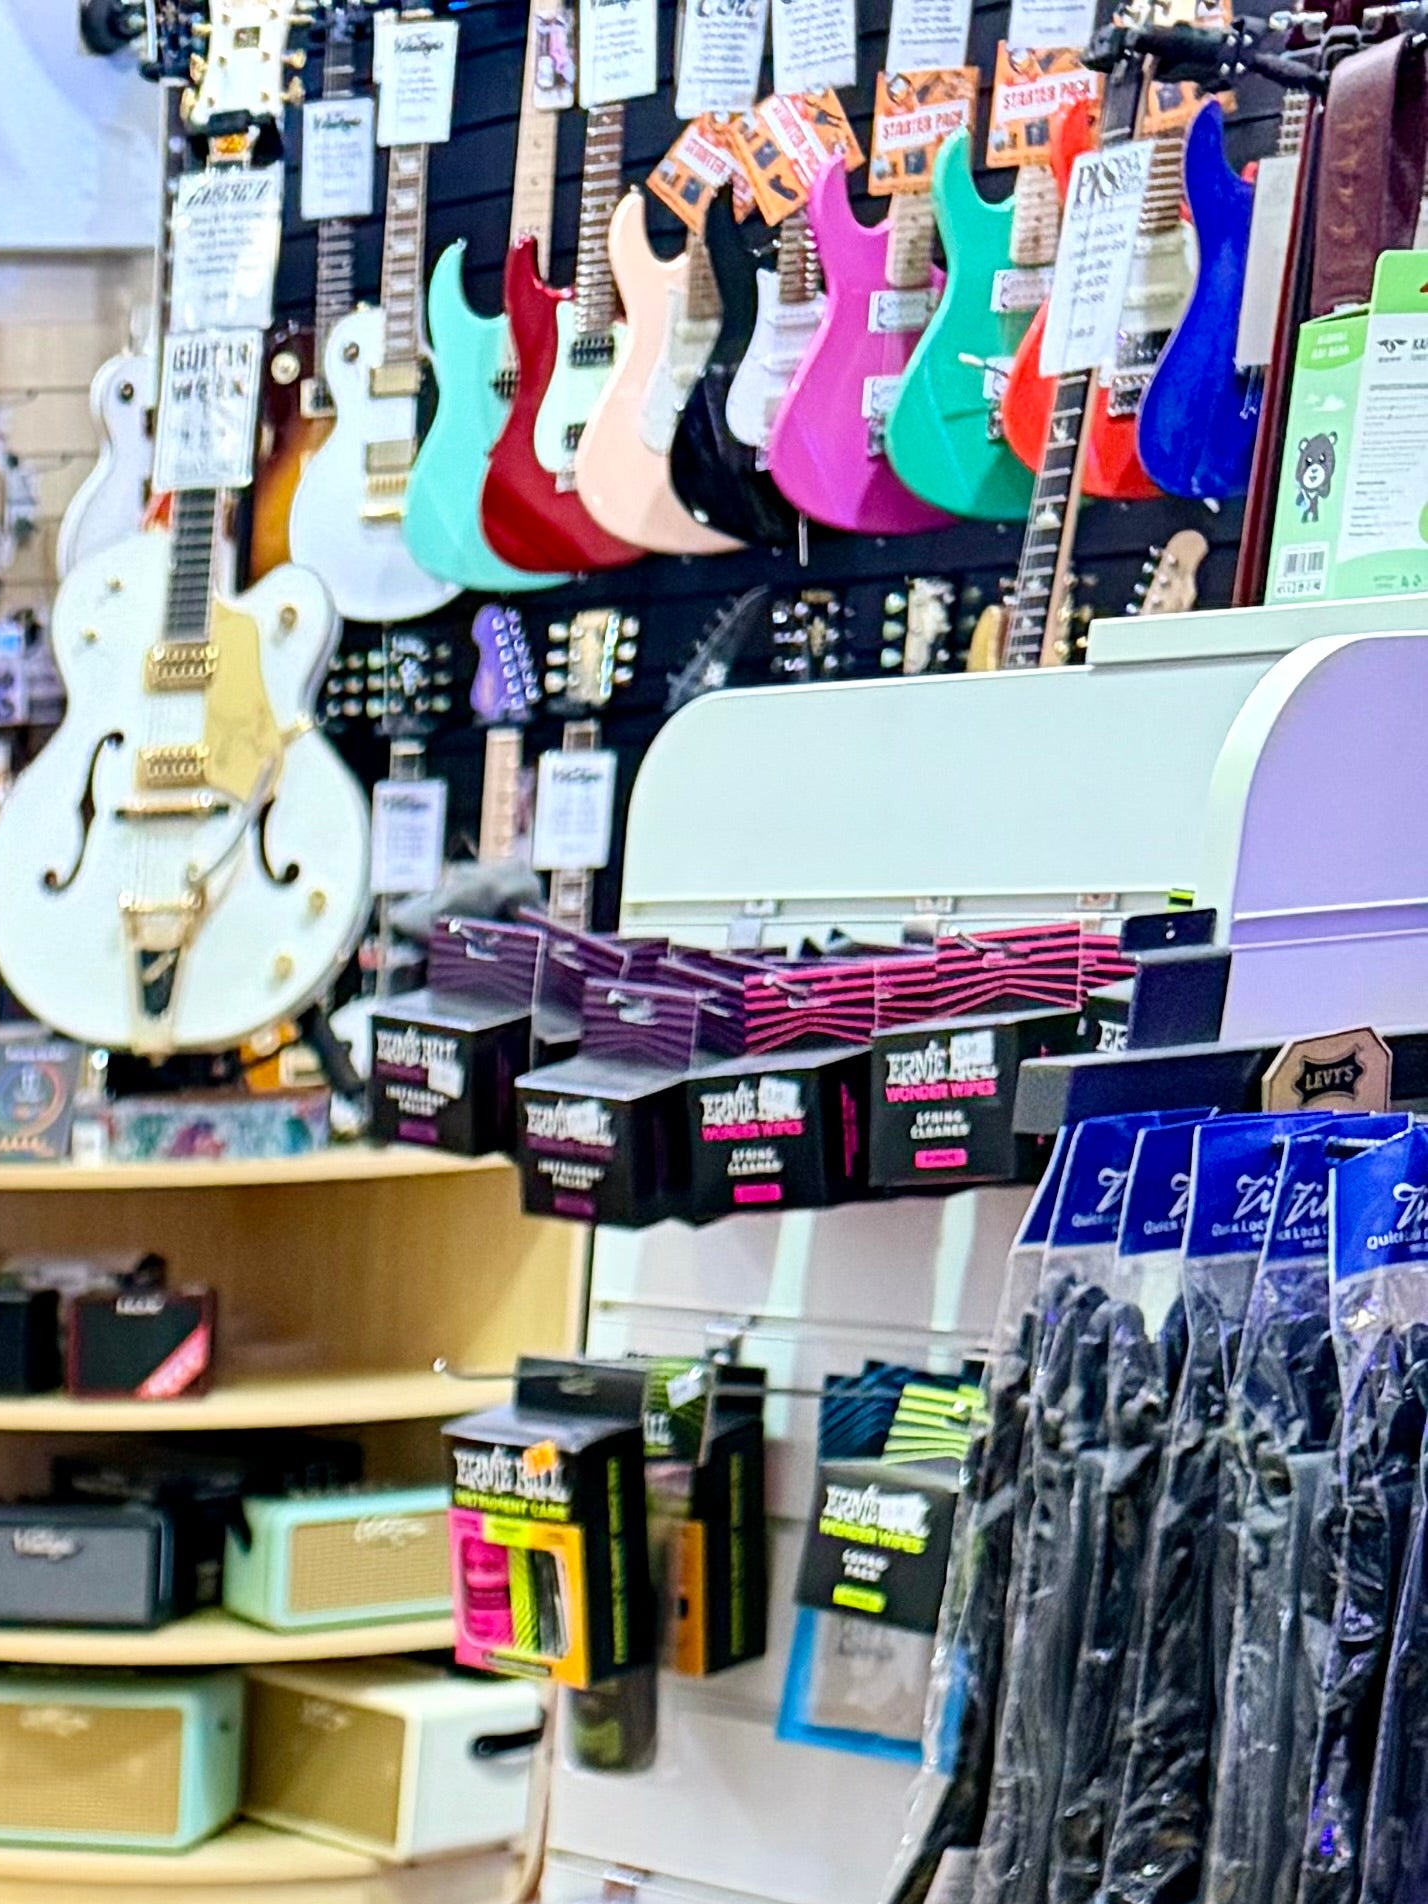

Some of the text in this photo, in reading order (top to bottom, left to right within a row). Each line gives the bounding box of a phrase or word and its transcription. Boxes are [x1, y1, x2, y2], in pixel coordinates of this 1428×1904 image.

[882, 116, 931, 139] STARTER
[886, 1039, 948, 1086] ERNIE
[885, 1079, 996, 1103] WONDER WIPES
[1304, 1064, 1356, 1092] LEVY'S
